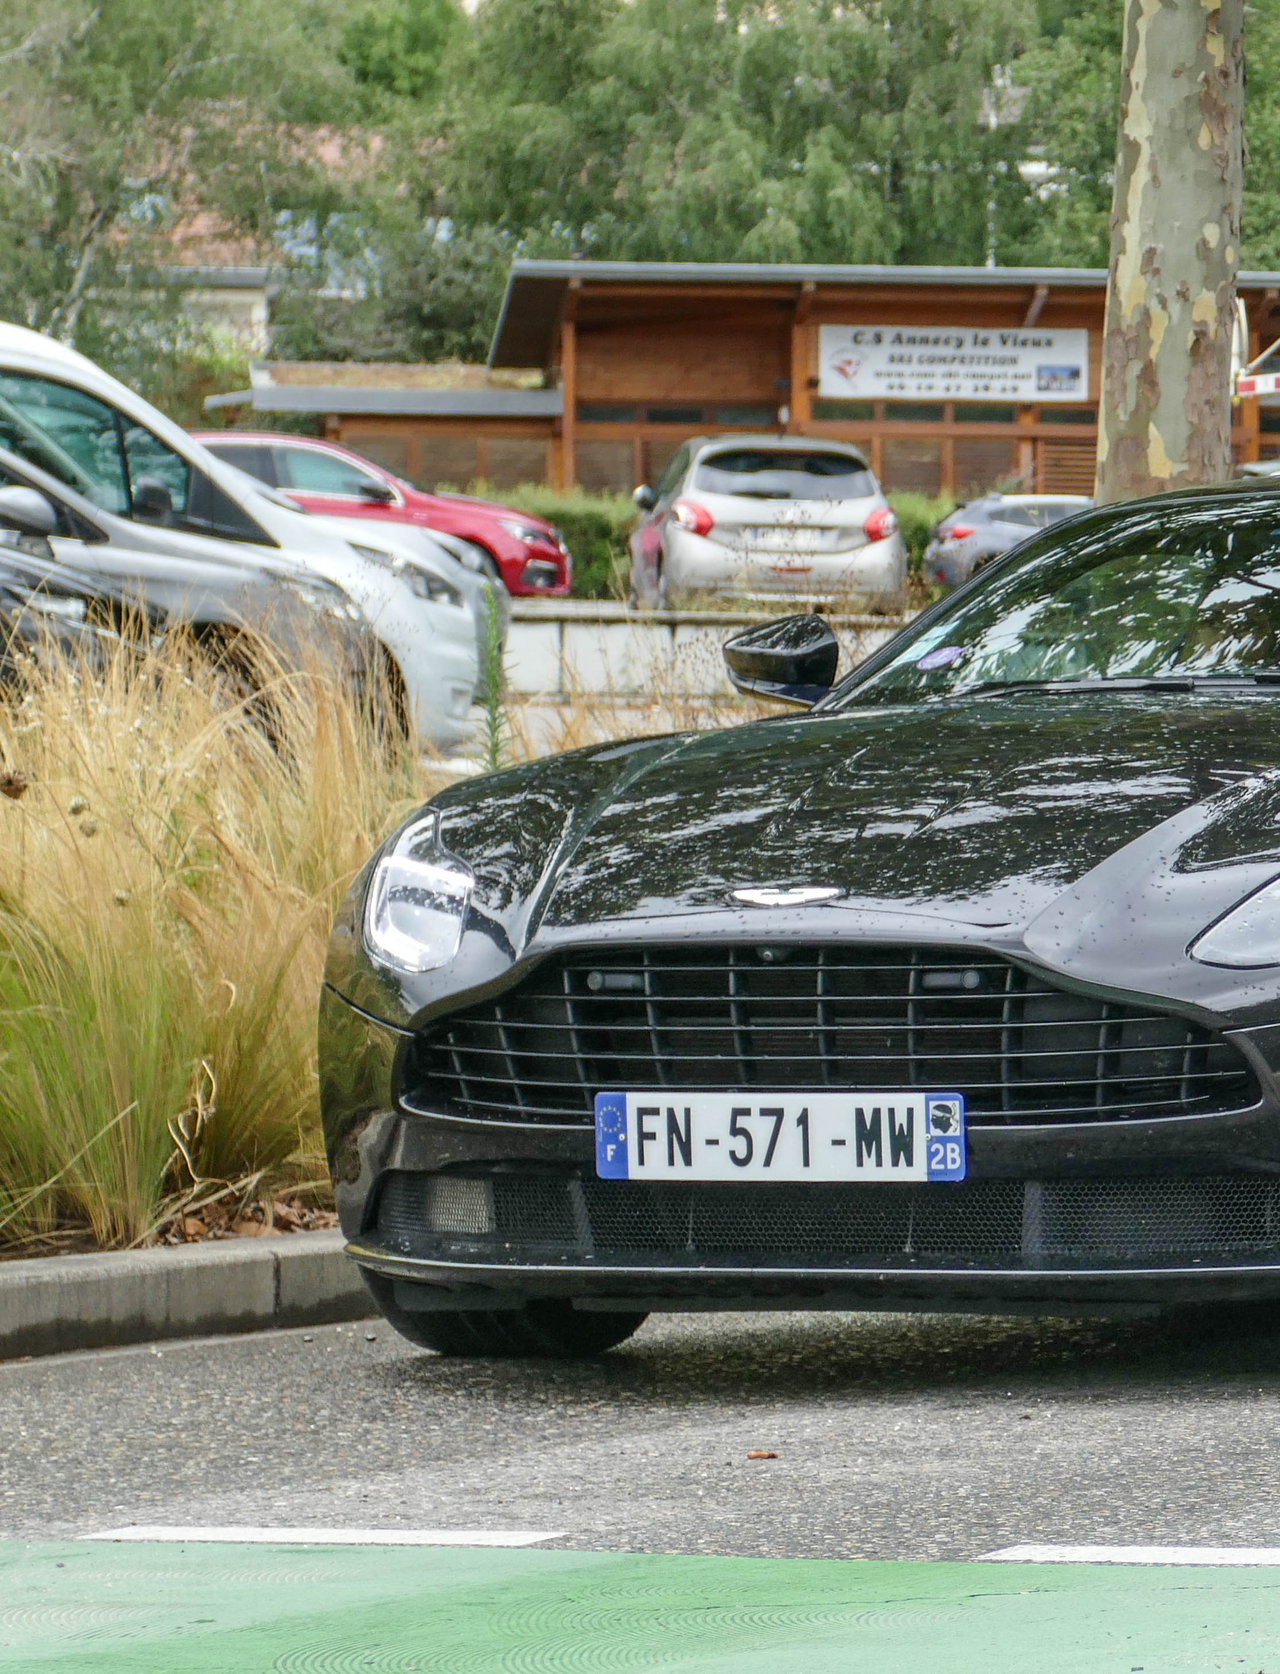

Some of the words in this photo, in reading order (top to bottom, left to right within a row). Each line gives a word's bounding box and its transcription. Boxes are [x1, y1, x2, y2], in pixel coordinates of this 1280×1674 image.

[891, 332, 964, 349] Annecy
[973, 332, 990, 347] le
[636, 1107, 914, 1168] FN-571-MW
[606, 1144, 616, 1162] F
[930, 1142, 961, 1170] 2B
